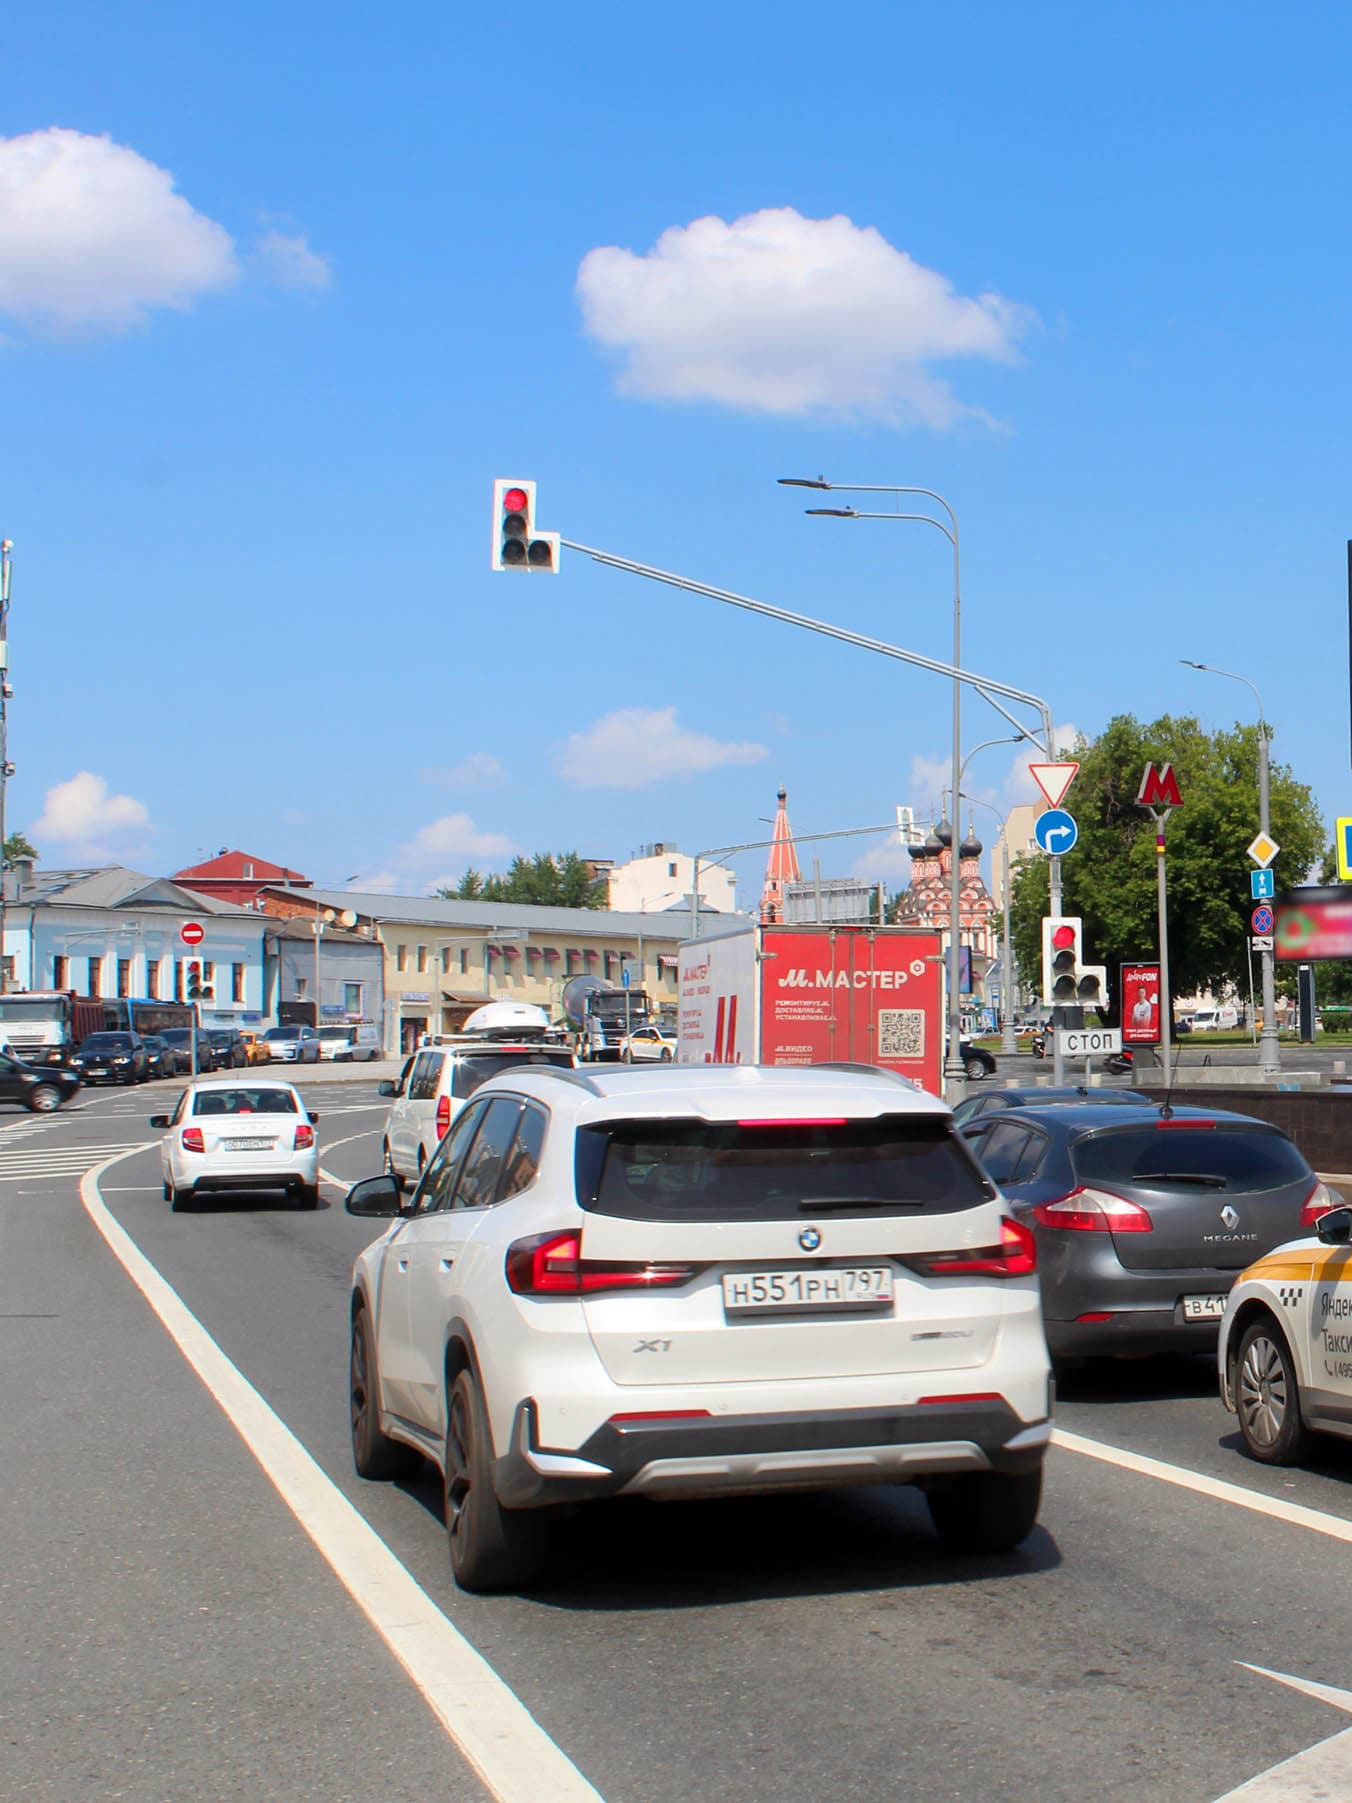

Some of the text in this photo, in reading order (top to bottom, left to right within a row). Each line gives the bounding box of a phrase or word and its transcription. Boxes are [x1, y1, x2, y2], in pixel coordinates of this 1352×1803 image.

[1135, 761, 1184, 806] М
[1068, 1034, 1112, 1050] СТОП
[1203, 1233, 1258, 1242] MEGANE
[734, 1270, 884, 1303] Н551РН 797
[1192, 1296, 1228, 1314] В41
[633, 1339, 672, 1353] X1
